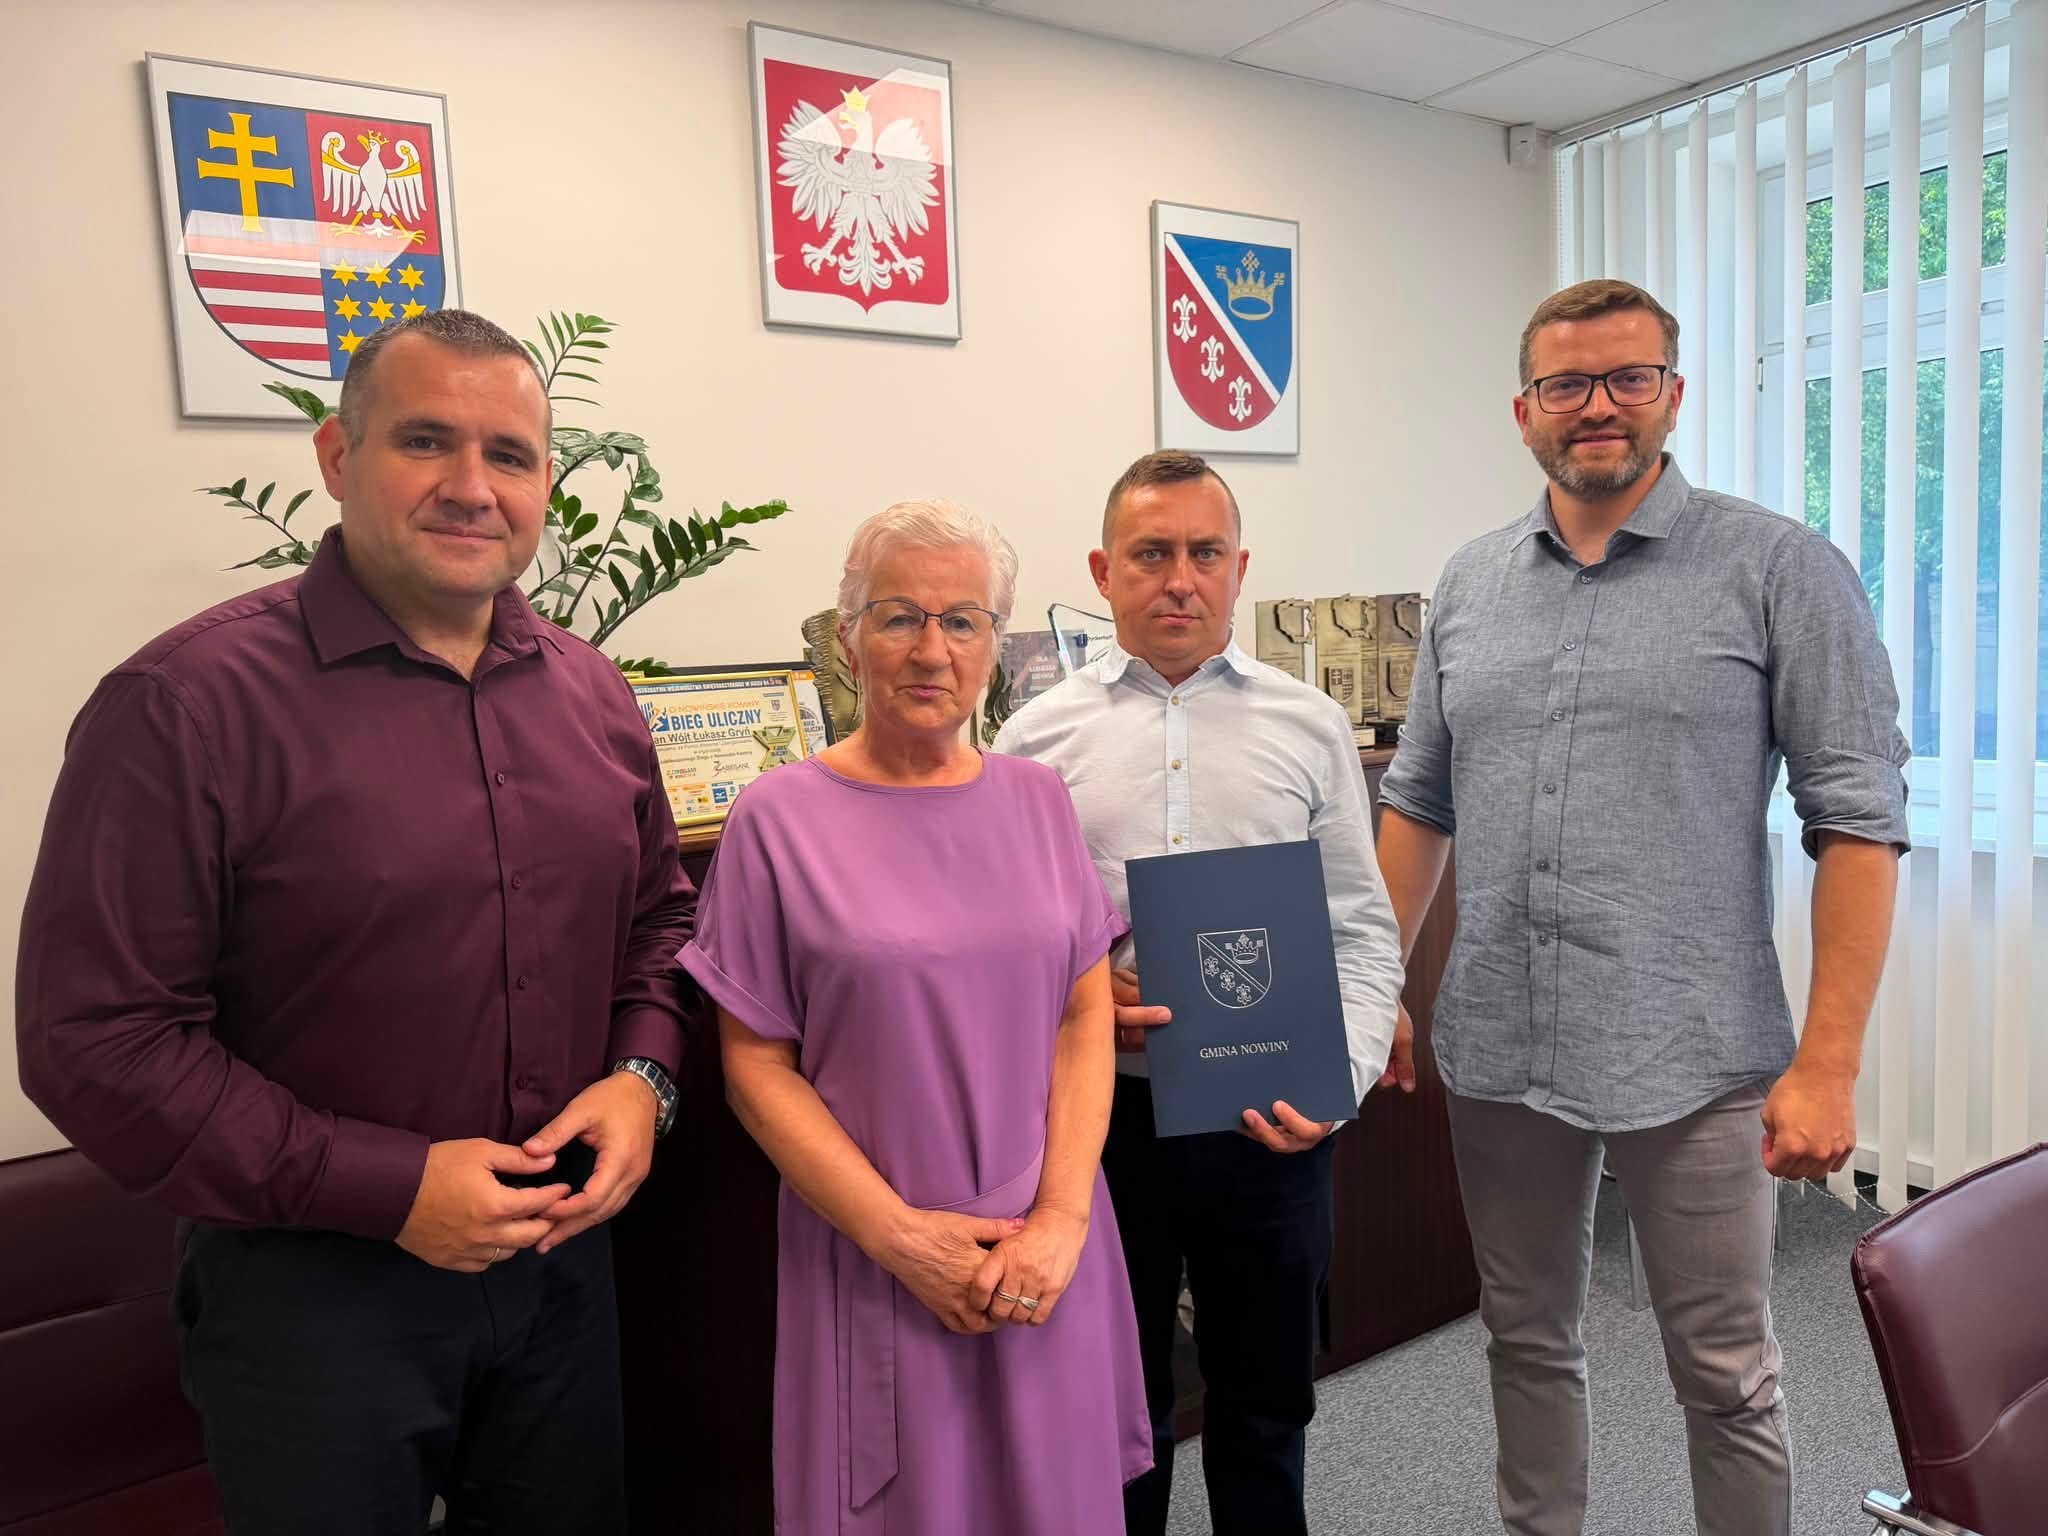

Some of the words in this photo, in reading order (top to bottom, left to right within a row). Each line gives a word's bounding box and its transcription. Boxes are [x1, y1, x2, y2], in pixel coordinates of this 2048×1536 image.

[671, 714, 704, 731] BIEG
[708, 709, 762, 728] ULICZNY
[654, 734, 666, 745] an
[668, 731, 691, 745] Wójt
[693, 729, 726, 742] Łukasz
[727, 727, 751, 740] Gryń
[1199, 1045, 1238, 1059] GMINA
[1240, 1040, 1290, 1055] NOWINY
